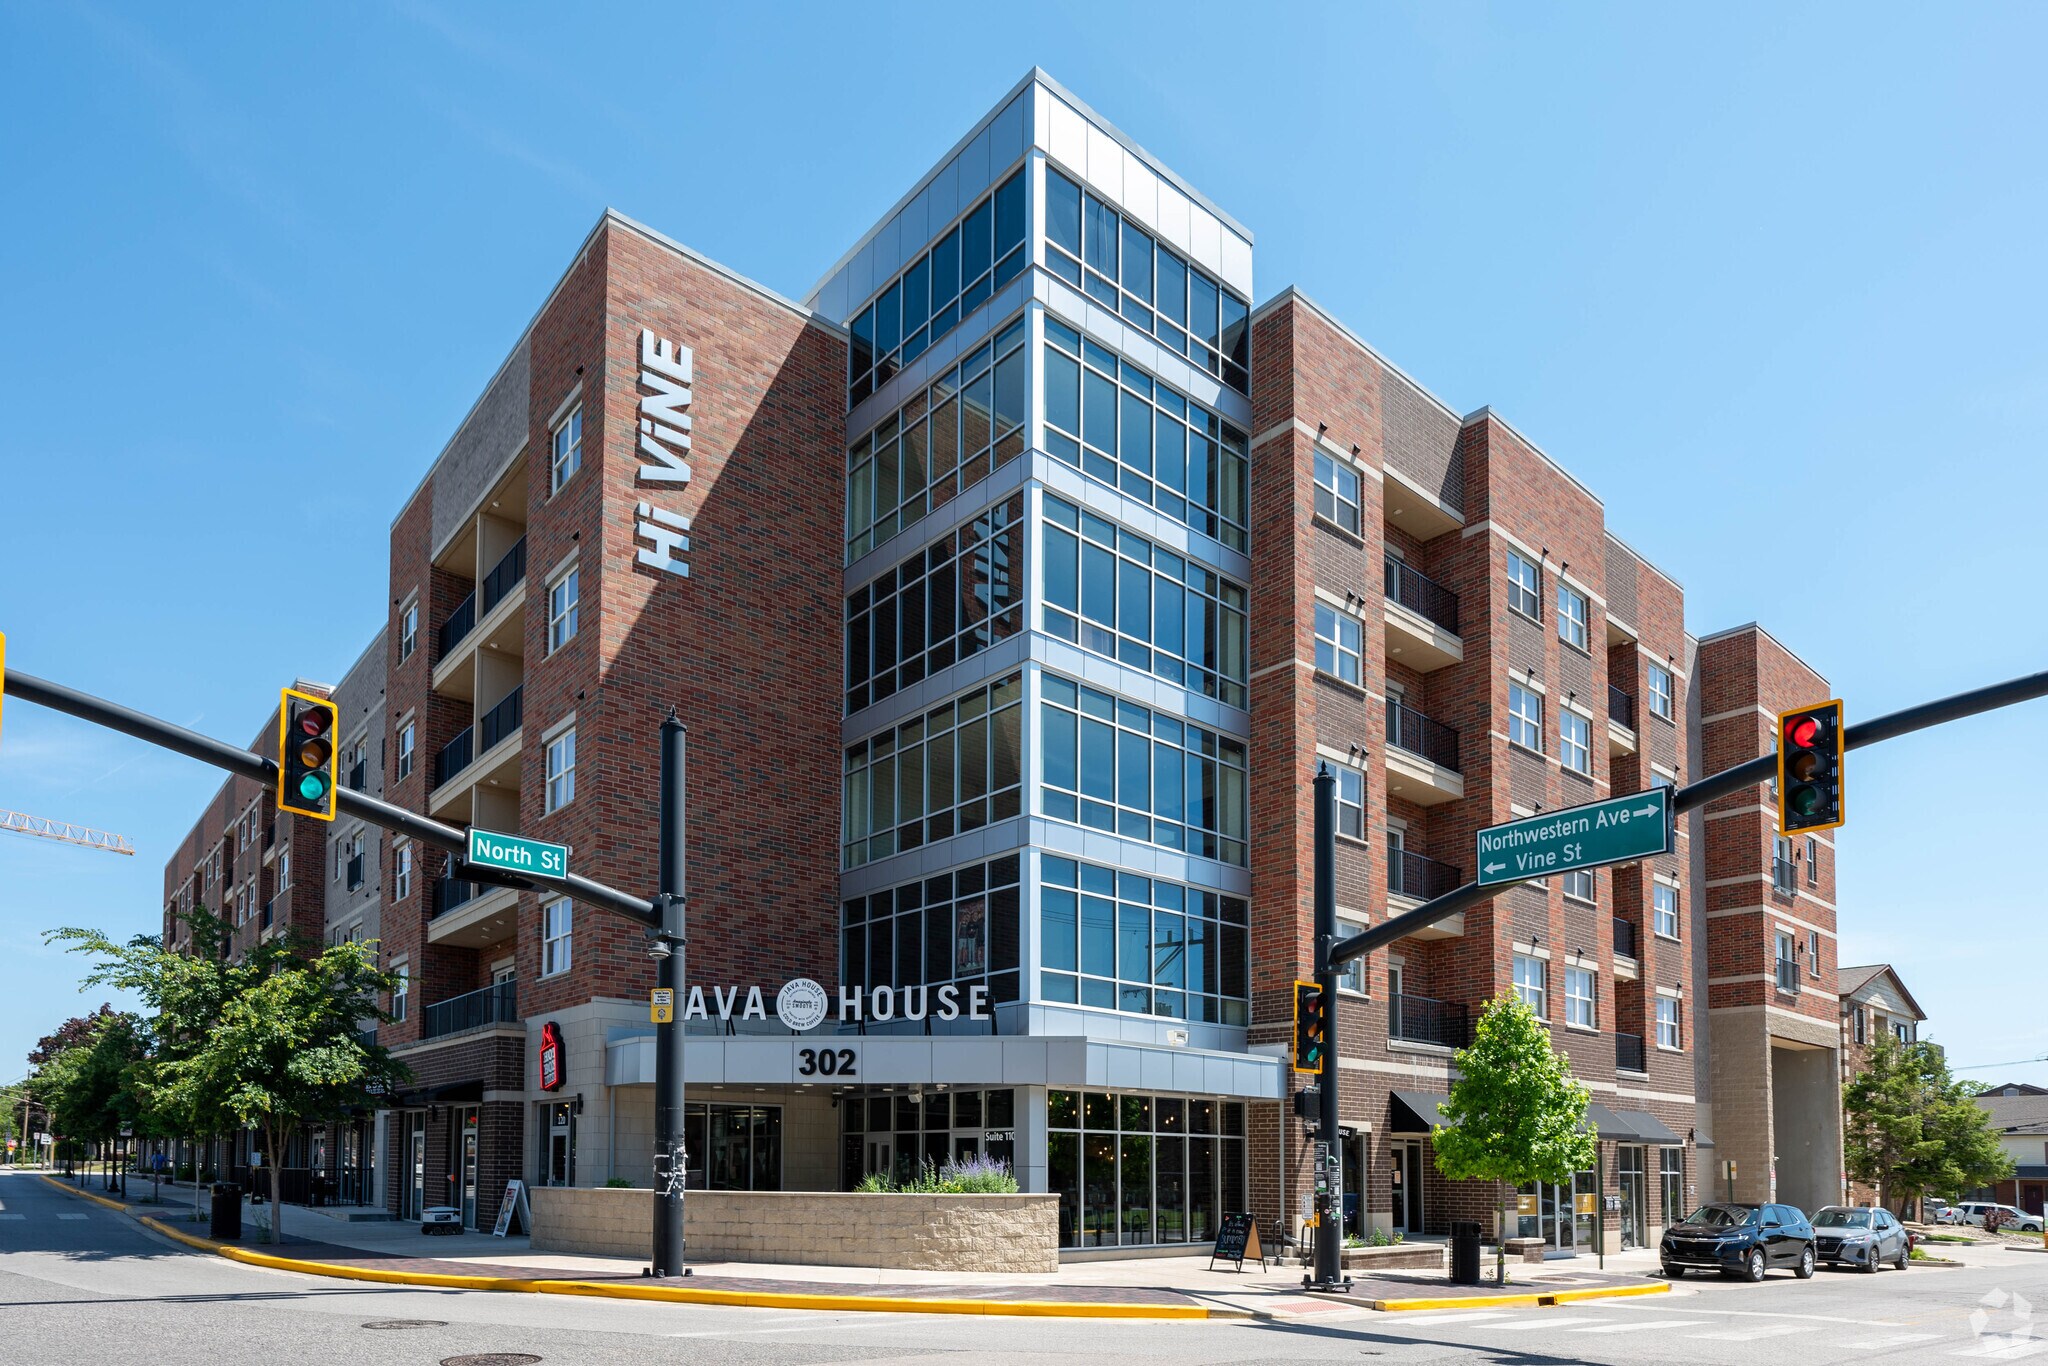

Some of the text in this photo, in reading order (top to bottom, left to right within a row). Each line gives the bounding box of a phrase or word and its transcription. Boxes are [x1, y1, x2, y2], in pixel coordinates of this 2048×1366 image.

[638, 501, 690, 579] Hi
[1481, 808, 1630, 854] Northwestern Ave
[476, 837, 561, 871] North St
[1515, 842, 1582, 871] Vine St
[683, 984, 990, 1021] AVA HOUSE
[784, 982, 800, 994] JAVA
[802, 982, 822, 996] HOUSE
[783, 1014, 792, 1023] COLD
[806, 1015, 820, 1026] COFFEE
[798, 1048, 857, 1076] 302
[986, 1132, 1004, 1141] Suite
